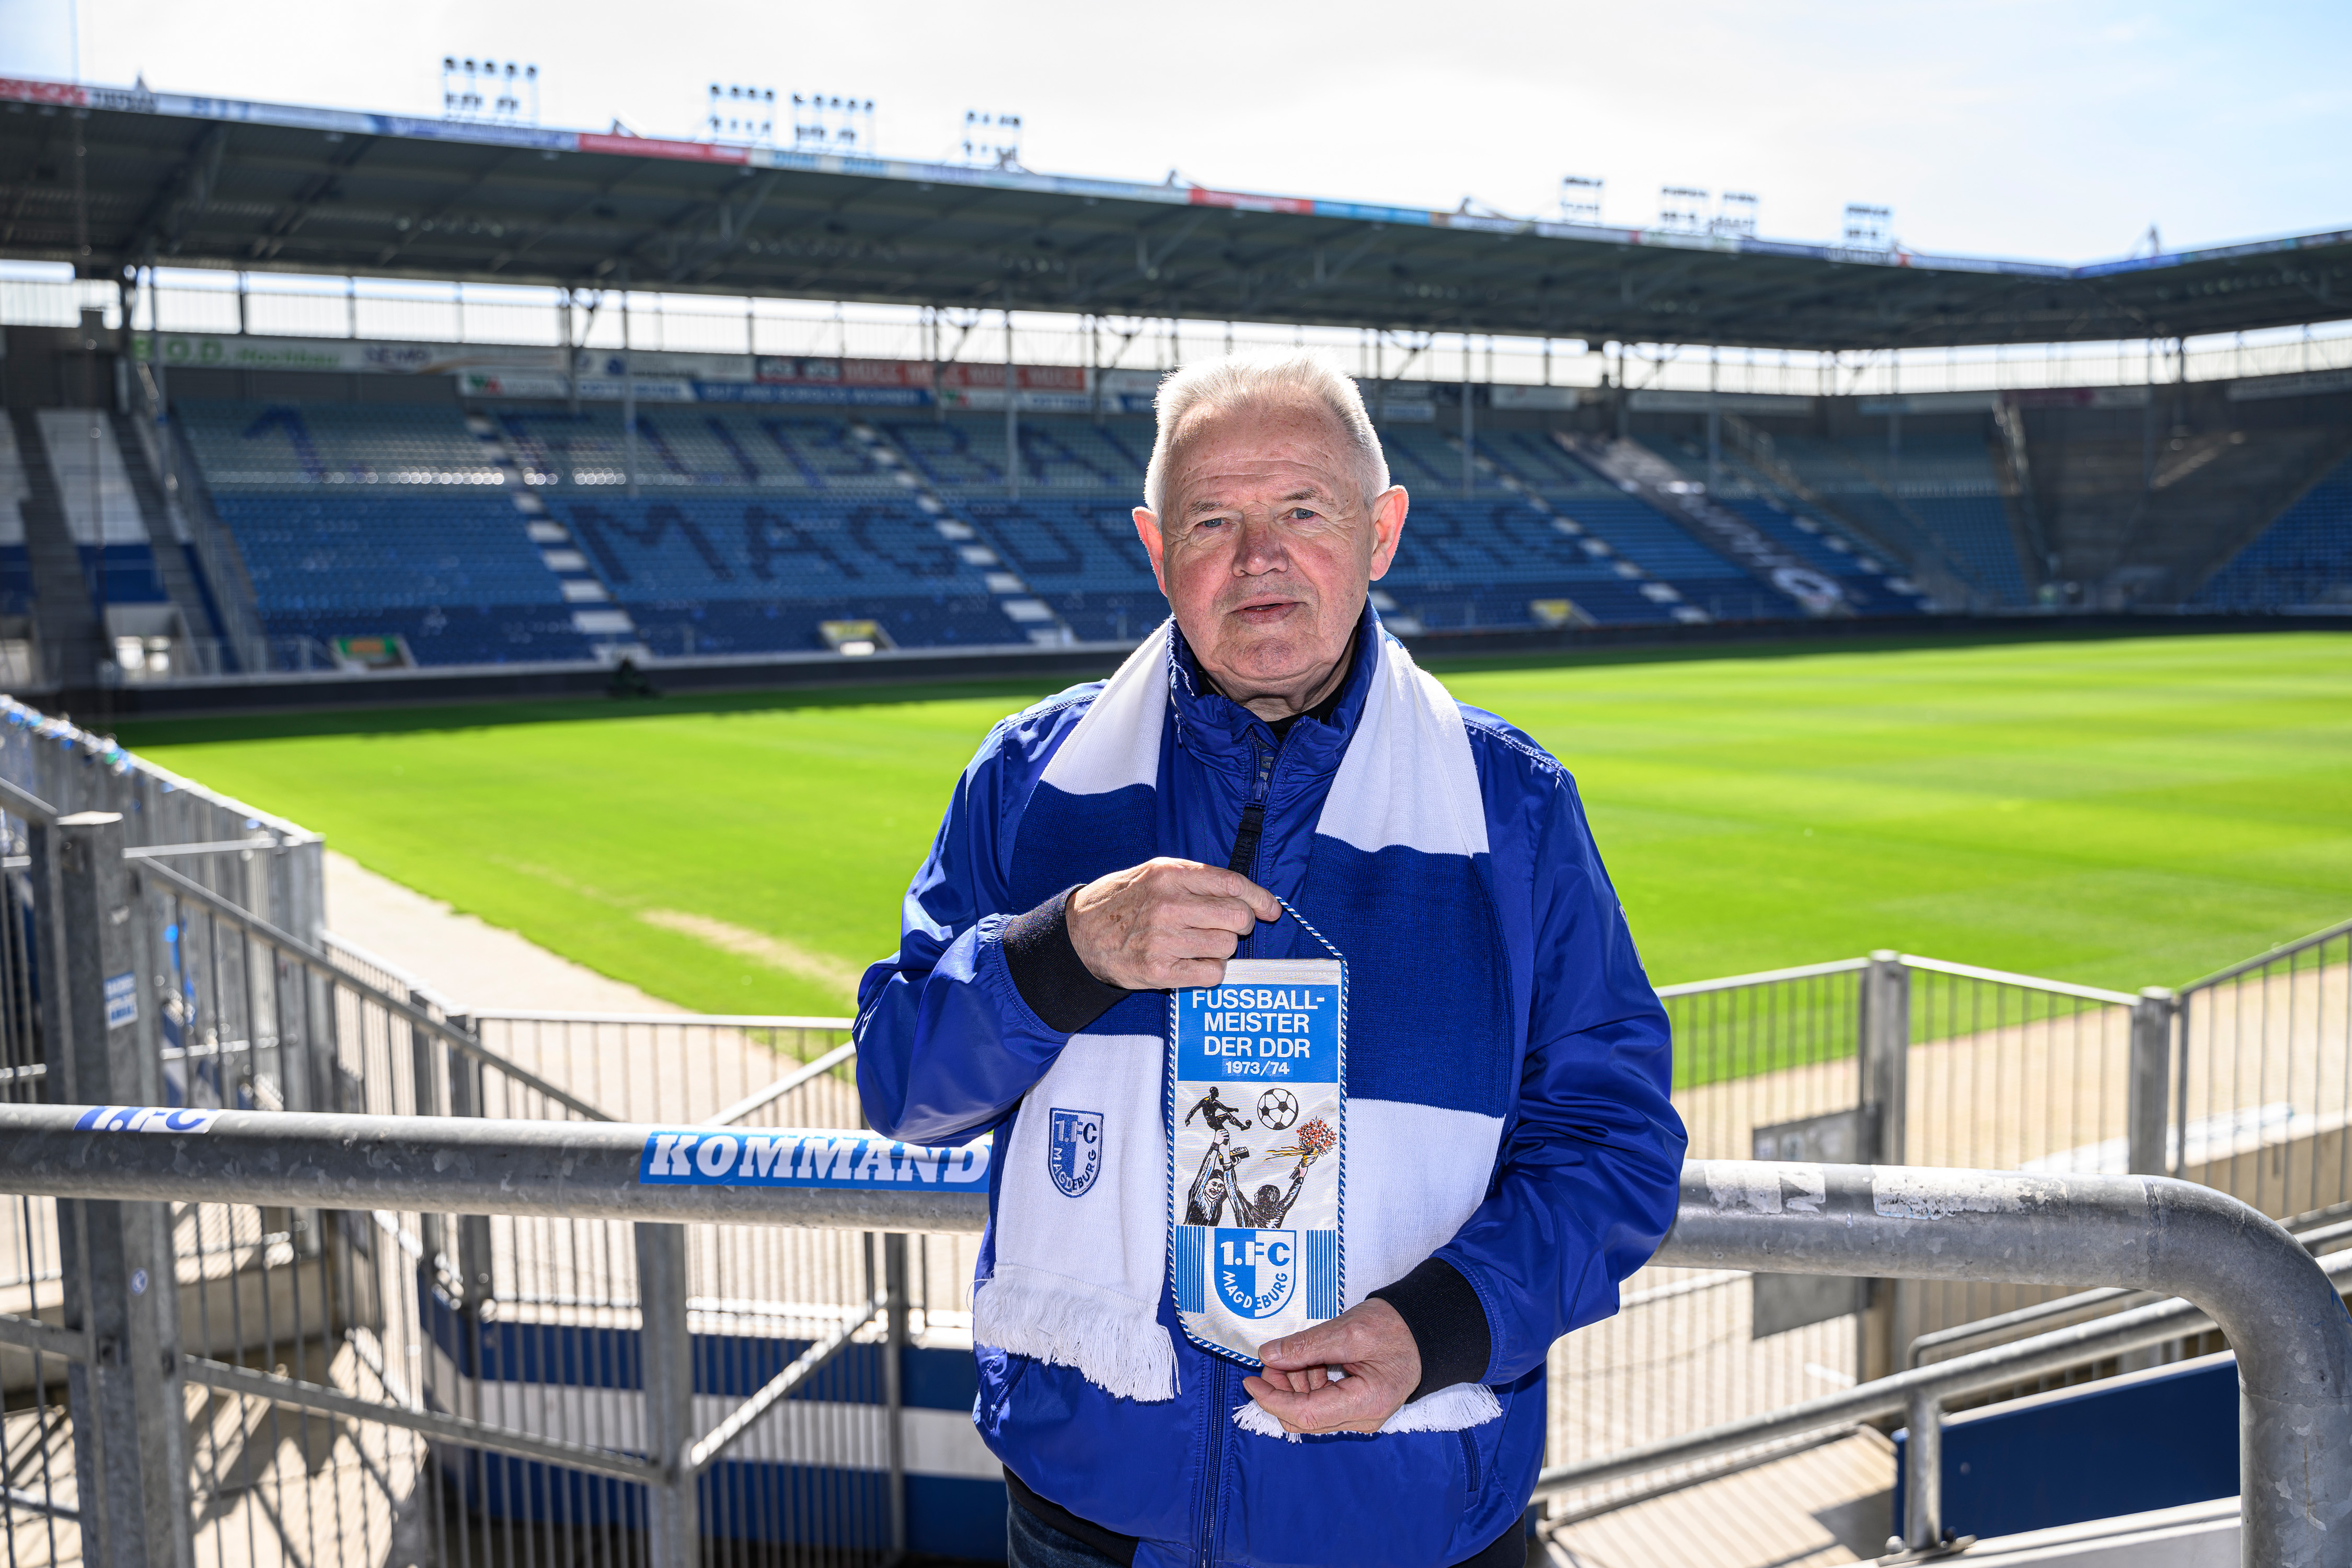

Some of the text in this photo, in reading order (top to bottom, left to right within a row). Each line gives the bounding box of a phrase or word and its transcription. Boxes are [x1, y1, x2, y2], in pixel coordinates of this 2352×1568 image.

[1192, 989, 1325, 1010] FUSSBALL-
[1204, 1012, 1309, 1033] MEISTER
[1204, 1036, 1310, 1058] DER DDR
[1225, 1060, 1290, 1076] 1973/74
[1053, 1147, 1097, 1191] MAGDEBURG
[1223, 1270, 1288, 1310] MAGDEBURG
